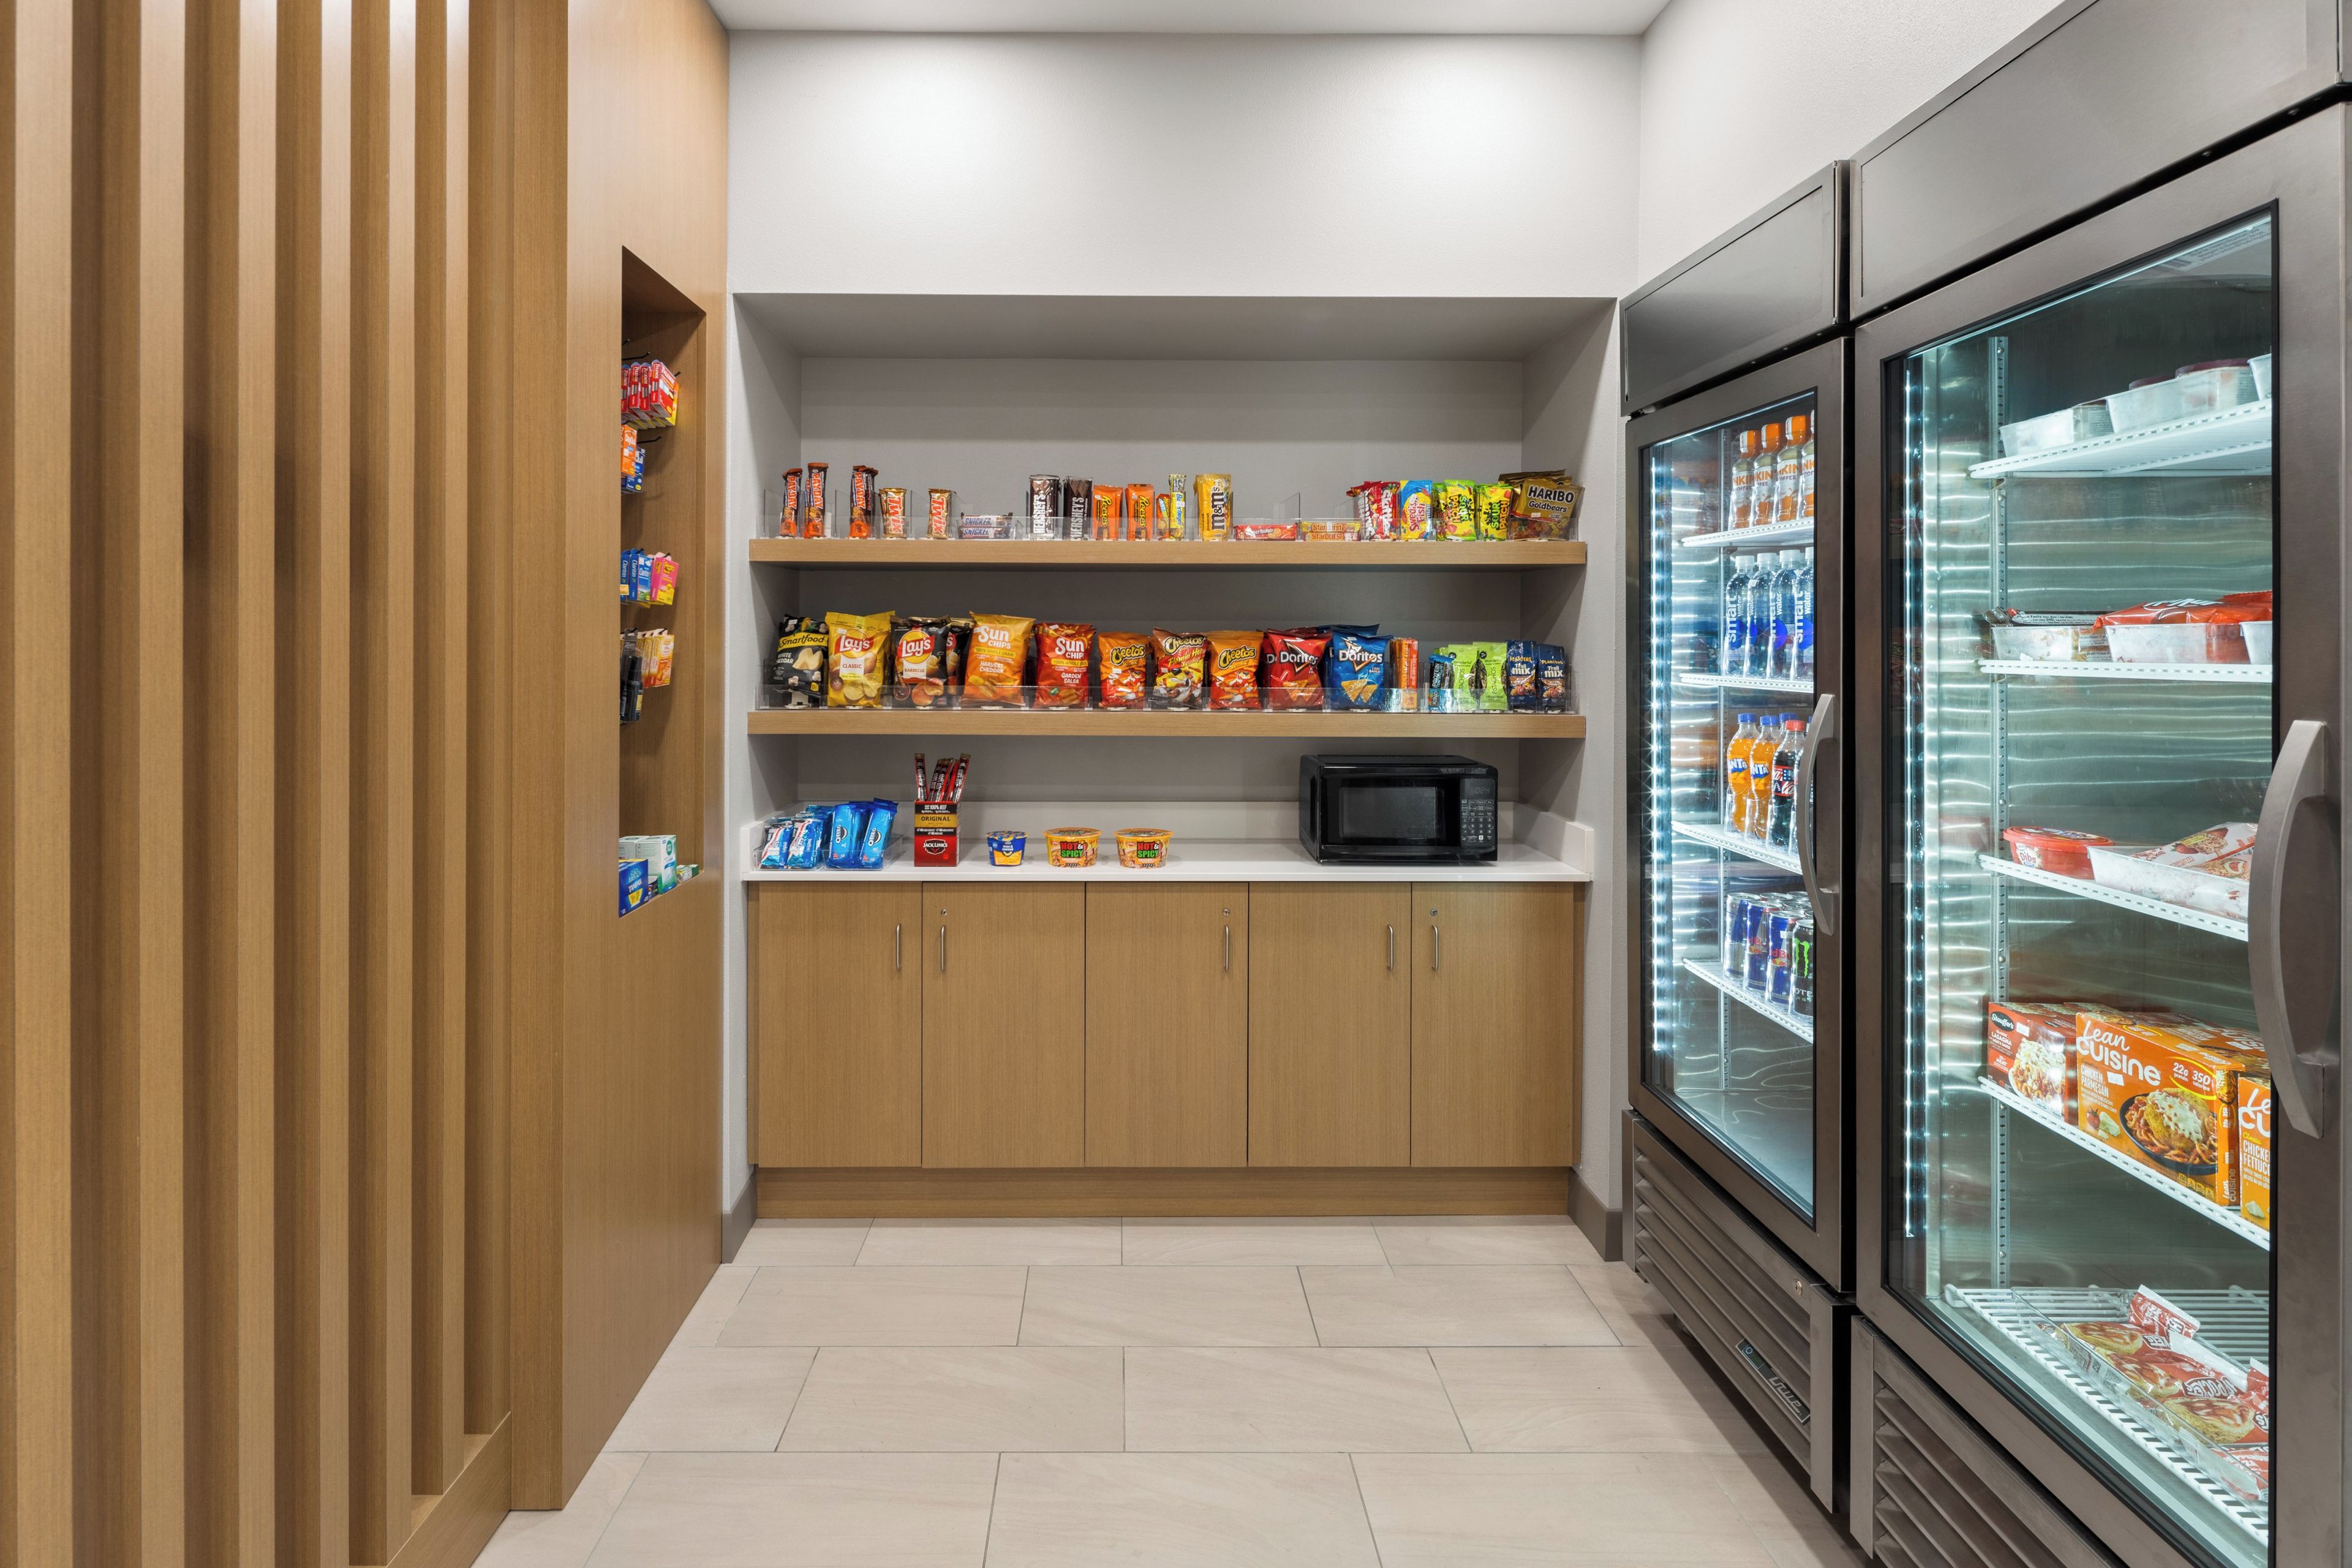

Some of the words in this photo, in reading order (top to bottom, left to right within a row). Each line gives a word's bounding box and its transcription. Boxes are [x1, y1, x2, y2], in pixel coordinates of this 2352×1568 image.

[812, 472, 823, 510] PAYDAY
[854, 472, 866, 510] PAYDAY
[1528, 485, 1575, 503] HARIBO
[1491, 502, 1500, 529] SOUR
[1499, 500, 1508, 529] PATCH
[1528, 500, 1568, 513] Goldbears
[965, 517, 992, 526] SNICKER
[1071, 497, 1085, 538] HERSHEY'S
[779, 634, 825, 648] Smartfood
[978, 625, 1009, 643] Sun
[840, 635, 870, 652] Lay's
[902, 637, 931, 658] Lay's
[988, 640, 1011, 649] CHIPS
[1055, 638, 1085, 655] Sun
[1164, 636, 1205, 655] Cheetos
[1218, 646, 1256, 669] Cheetos
[1280, 651, 1318, 665] Doritos
[1338, 649, 1383, 663] Doritos
[868, 827, 876, 846] OREO
[2019, 852, 2037, 864] Dibs
[1991, 1013, 2015, 1030] Stouffer's
[2082, 1020, 2130, 1052] Lean
[2081, 1064, 2103, 1084] CHICKEN
[2192, 1070, 2211, 1085] 350
[2081, 1075, 2109, 1098] PARMESAN
[2247, 1088, 2271, 1114] Le
[2242, 1131, 2261, 1145] Classic
